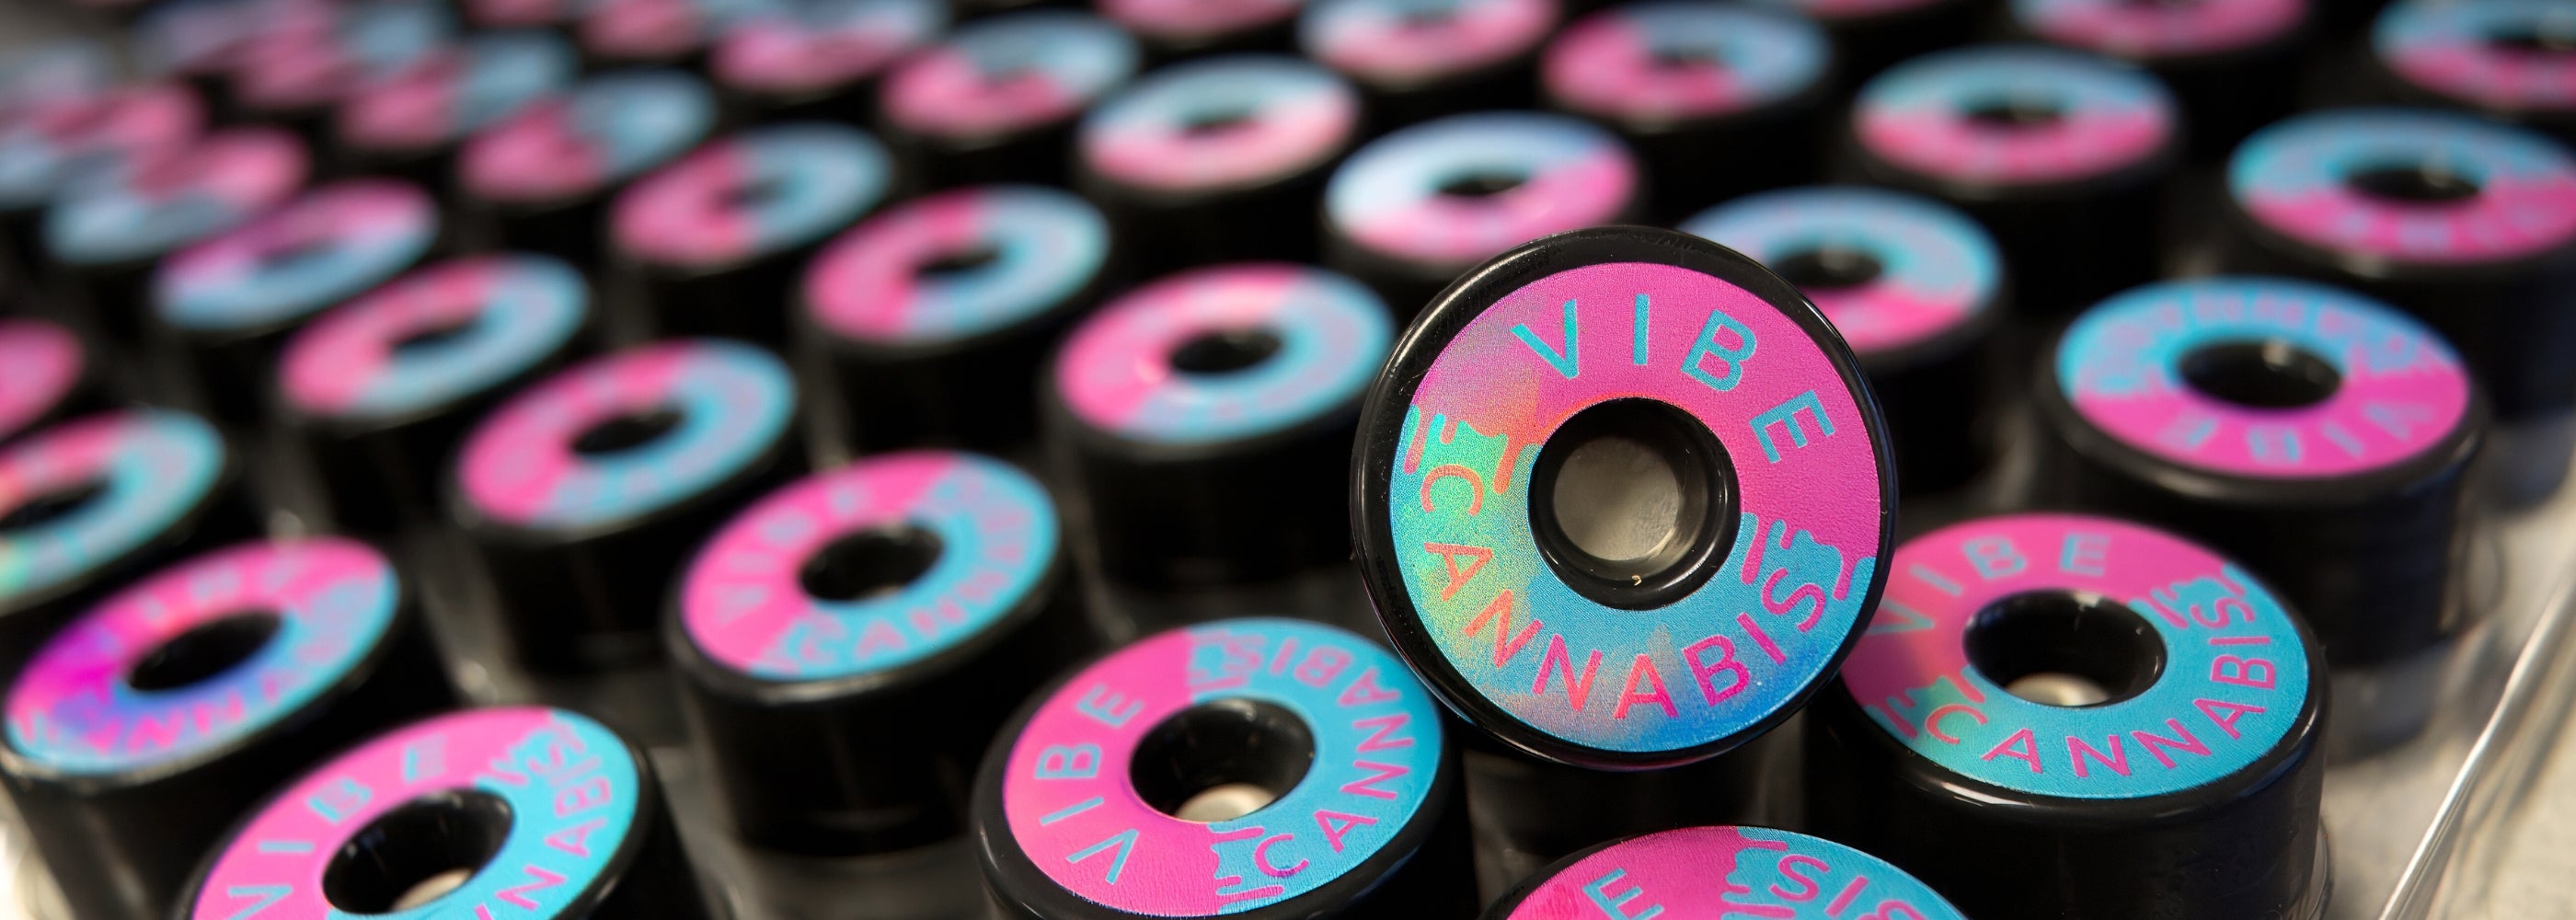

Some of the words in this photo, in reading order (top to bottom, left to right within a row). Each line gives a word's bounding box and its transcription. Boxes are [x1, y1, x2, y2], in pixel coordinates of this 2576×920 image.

[1510, 293, 1835, 464] VIBE
[1420, 464, 1826, 719] CANNABIS
[1865, 532, 2111, 636] VIBE
[1223, 635, 1415, 878] CANNABIS
[1925, 596, 2276, 778] CANNABIS
[474, 729, 611, 920] NABIS
[1035, 684, 1144, 885] VIBE
